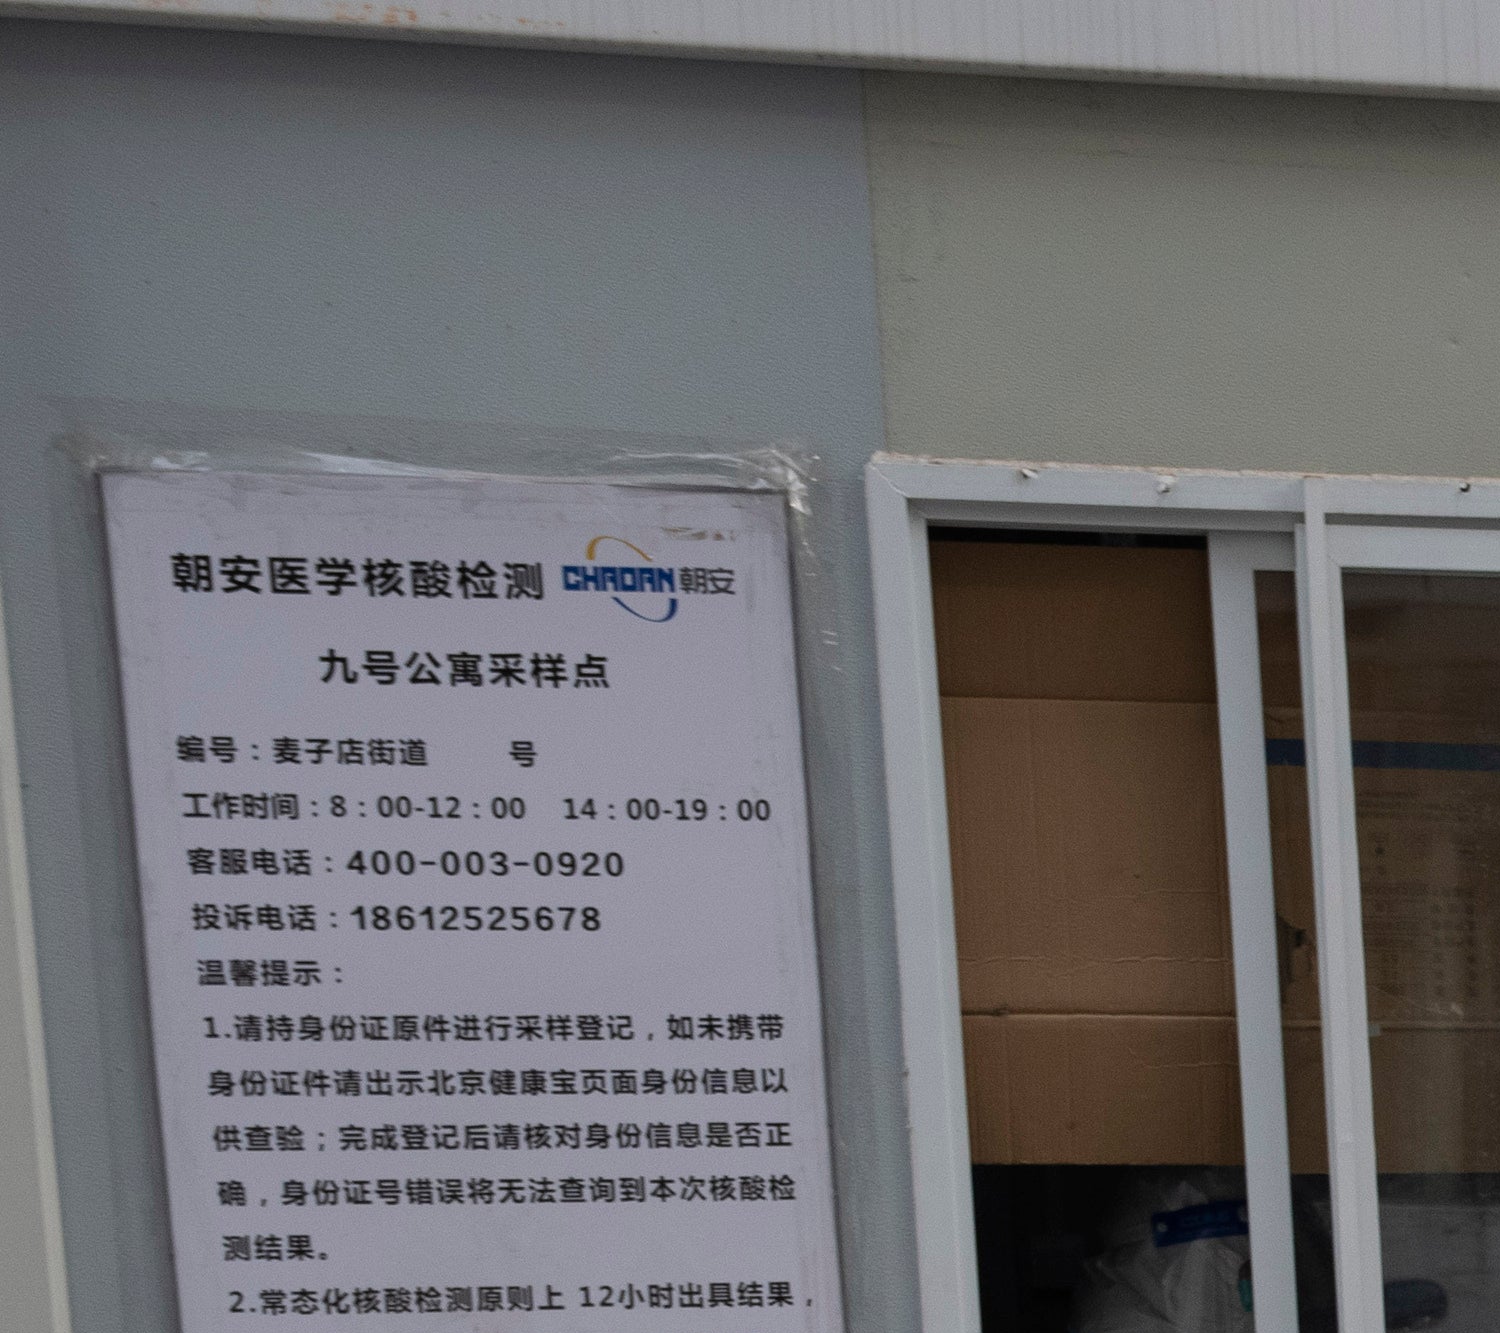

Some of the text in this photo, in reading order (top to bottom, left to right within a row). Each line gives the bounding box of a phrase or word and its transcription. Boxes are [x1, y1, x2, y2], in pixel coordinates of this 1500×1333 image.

[170, 552, 544, 600] 朝安医学核酸检测
[679, 567, 735, 595] 朝安
[319, 649, 609, 688] 九号公寓采样点
[176, 736, 537, 767] 编号：麦子店街道 号
[197, 959, 342, 987] 温馨提示：
[208, 1068, 788, 1097] 身份证件请出示北京健康宝页面身份信息以
[223, 1234, 327, 1261] 测结果。
